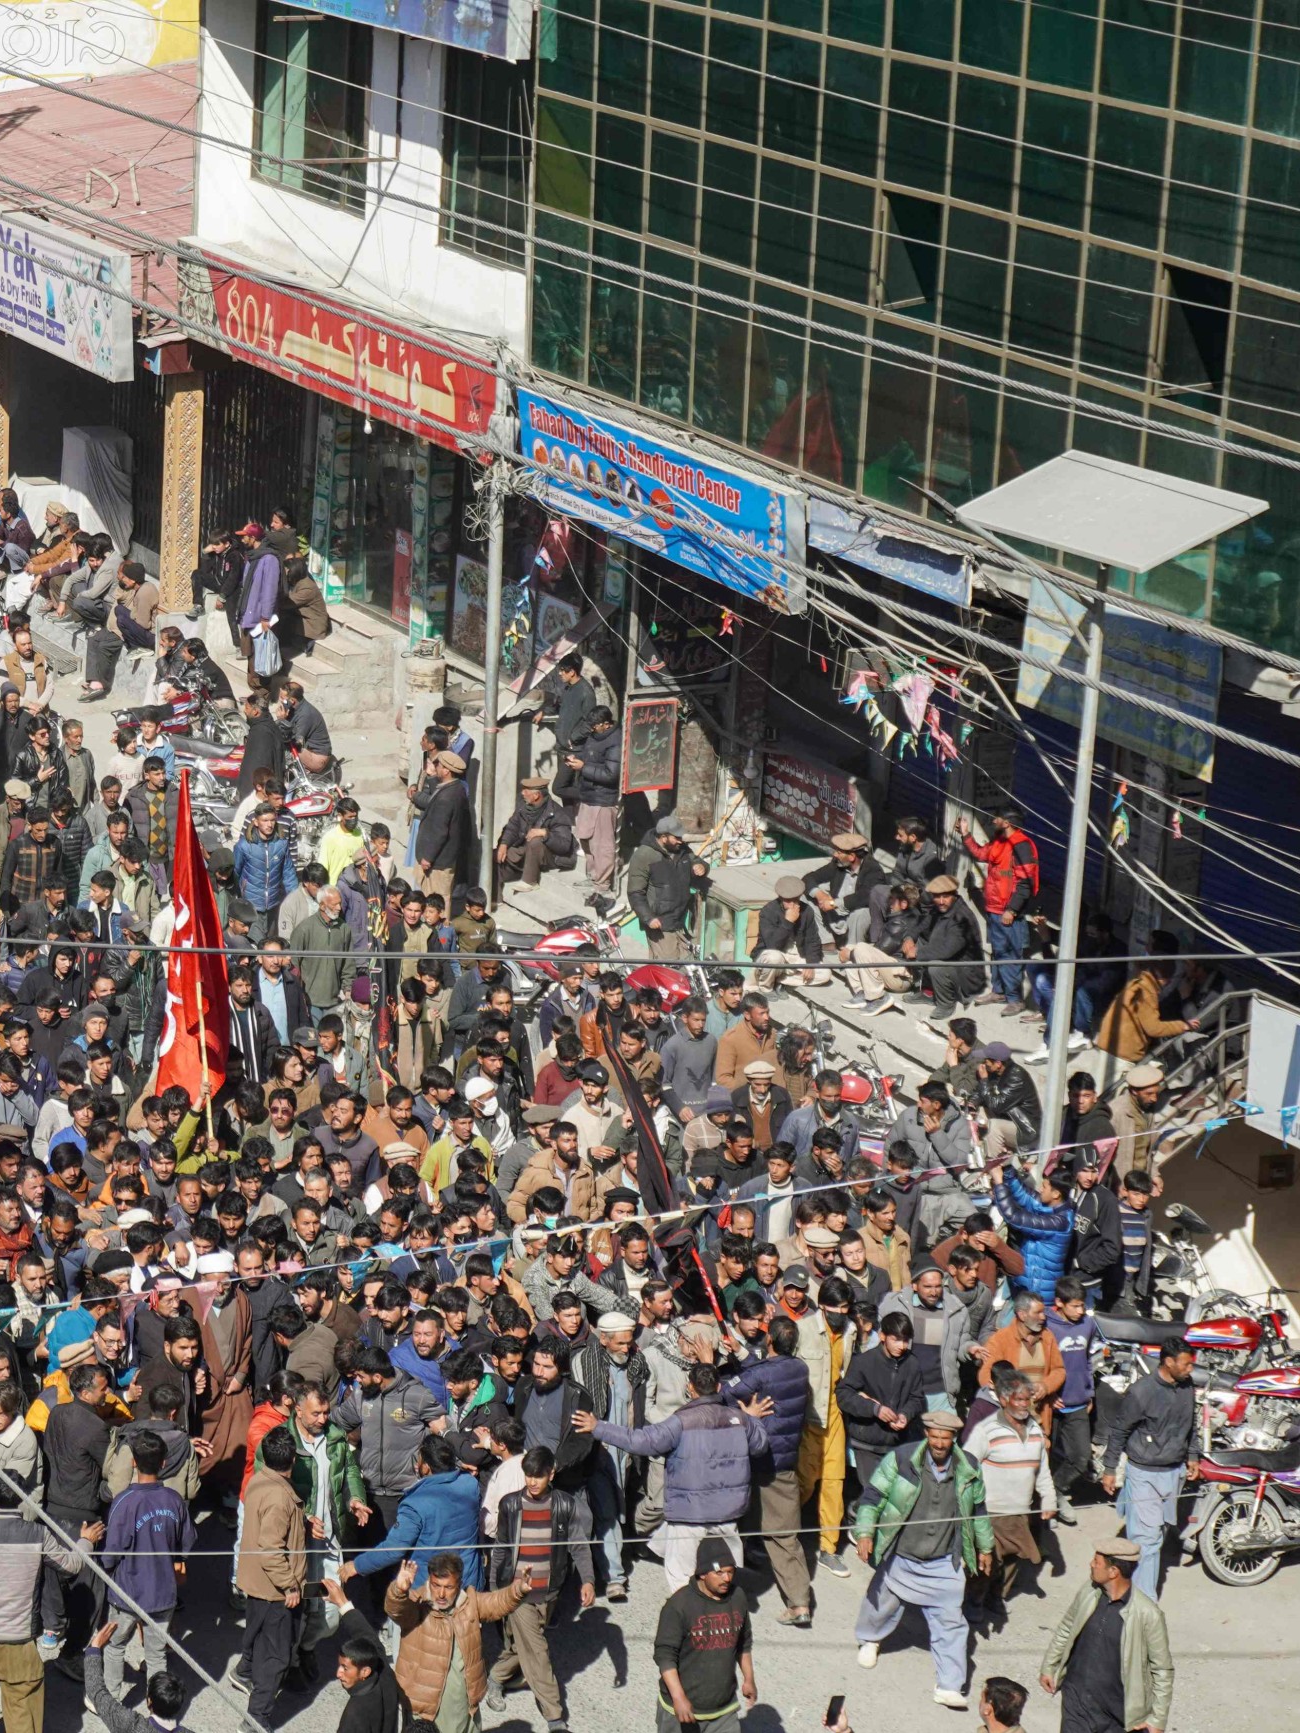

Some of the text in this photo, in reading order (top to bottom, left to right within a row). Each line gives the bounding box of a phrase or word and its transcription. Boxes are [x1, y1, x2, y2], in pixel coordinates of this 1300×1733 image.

[0, 276, 6, 293] &
[6, 279, 20, 302] Dry
[21, 285, 42, 309] Fruits
[226, 277, 277, 356] 804
[360, 332, 457, 423] کوئٹہ
[528, 402, 742, 516] Fahad Dry Fruit & Handicraft Center
[633, 725, 669, 755] ہوٹل
